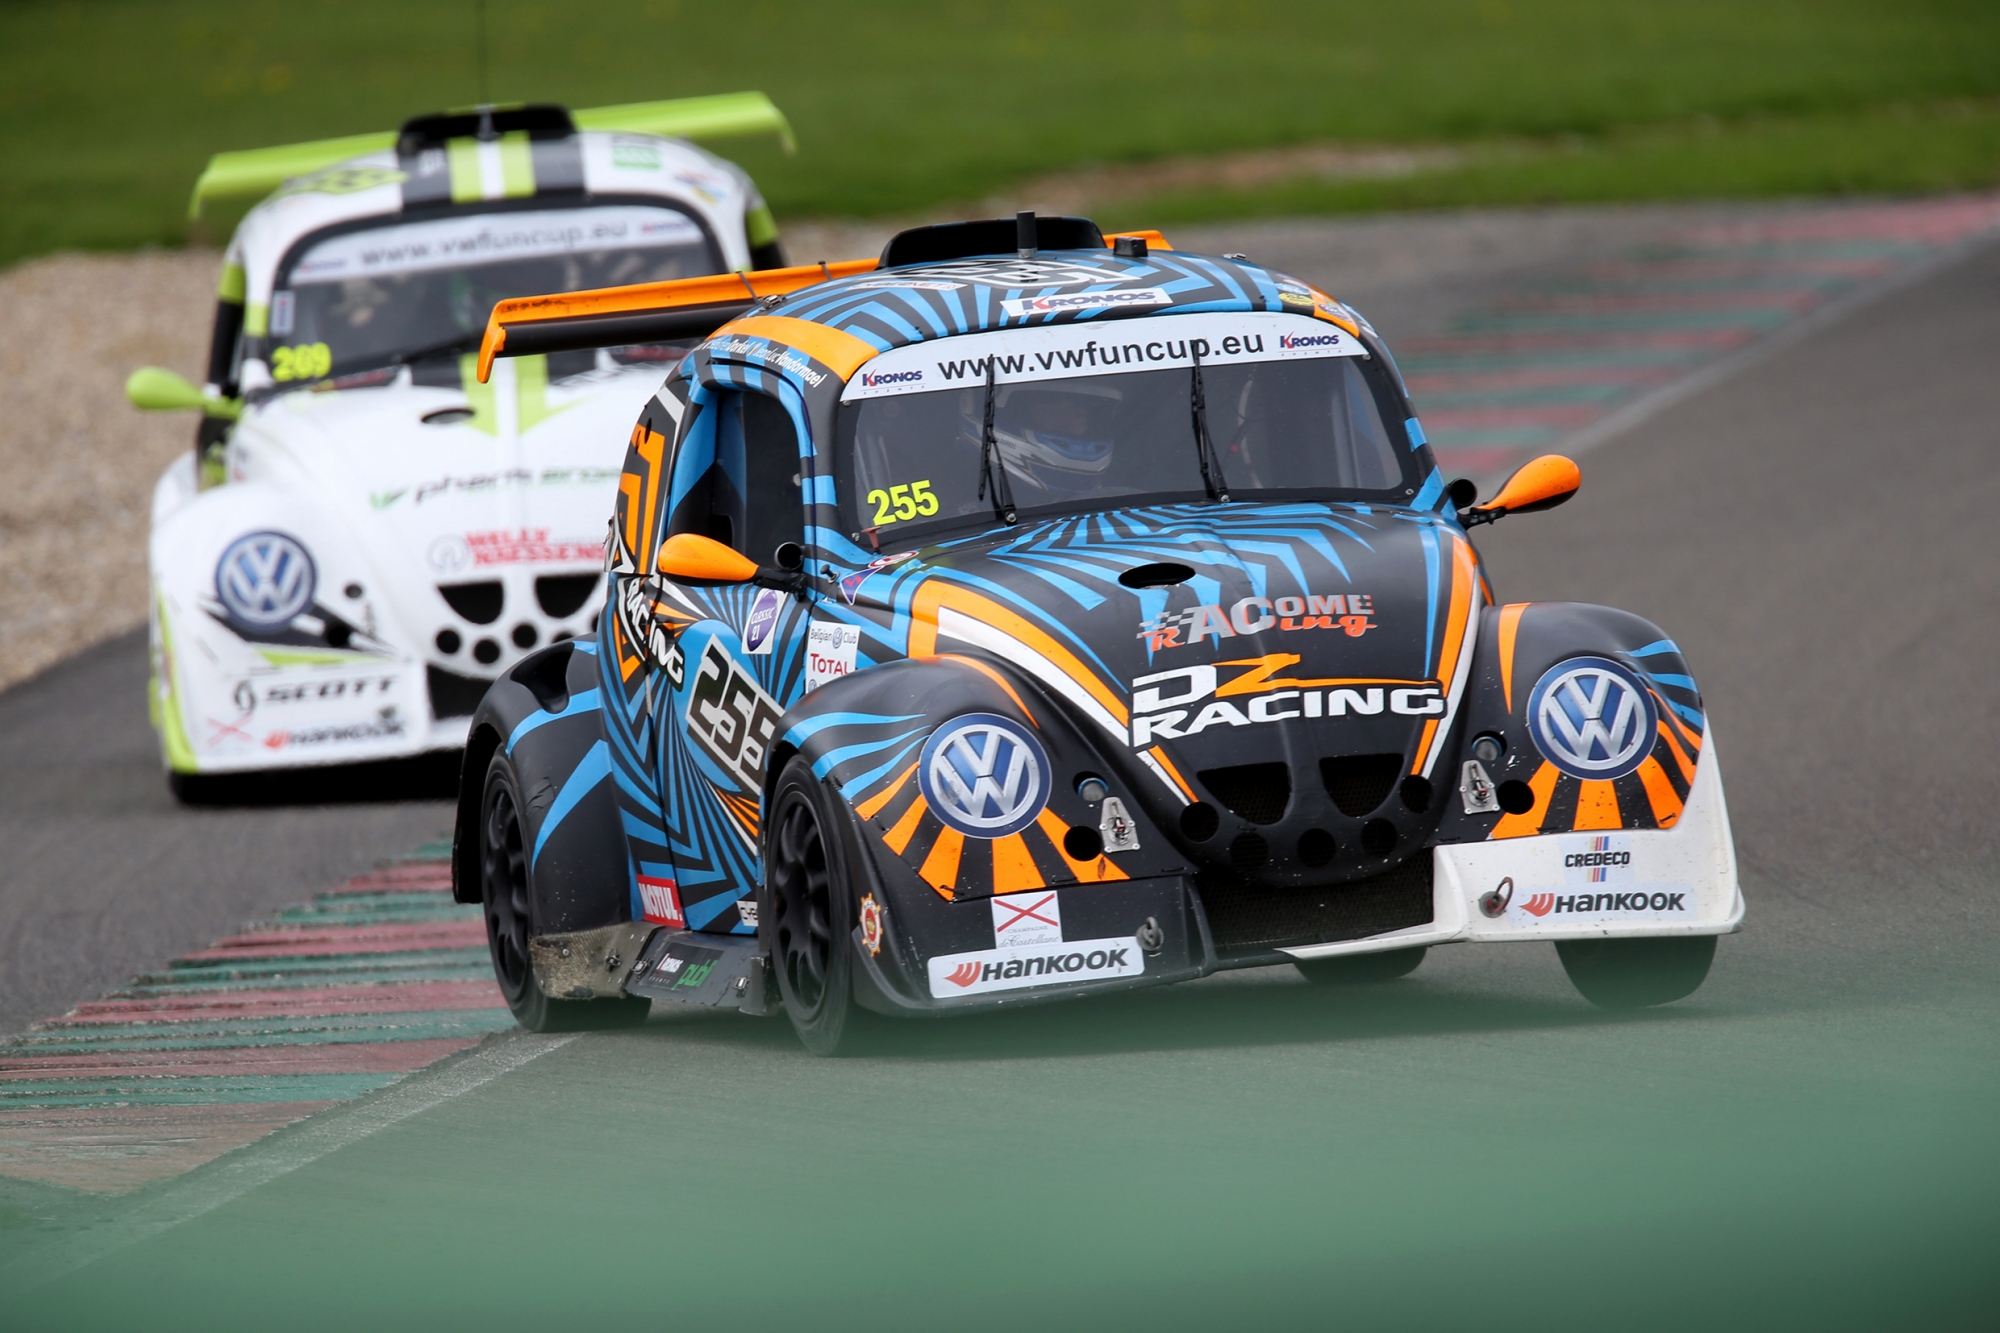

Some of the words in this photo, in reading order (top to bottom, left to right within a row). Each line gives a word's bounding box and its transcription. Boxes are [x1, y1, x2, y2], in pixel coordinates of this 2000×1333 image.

[1022, 292, 1156, 311] KRONOS
[1280, 332, 1340, 349] KRONOS
[272, 341, 332, 383] 209
[937, 333, 1264, 380] www.vwfuncup.eu
[862, 369, 924, 387] KRONOS
[867, 480, 940, 526] 255
[751, 607, 776, 625] CLASSIC
[751, 625, 761, 641] 21
[843, 630, 857, 644] Club
[810, 653, 850, 675] TOTAL
[267, 678, 395, 703] SCOTT
[1132, 688, 1444, 747] RACING
[1565, 851, 1631, 868] CREDECO
[638, 883, 679, 921] MOTUL
